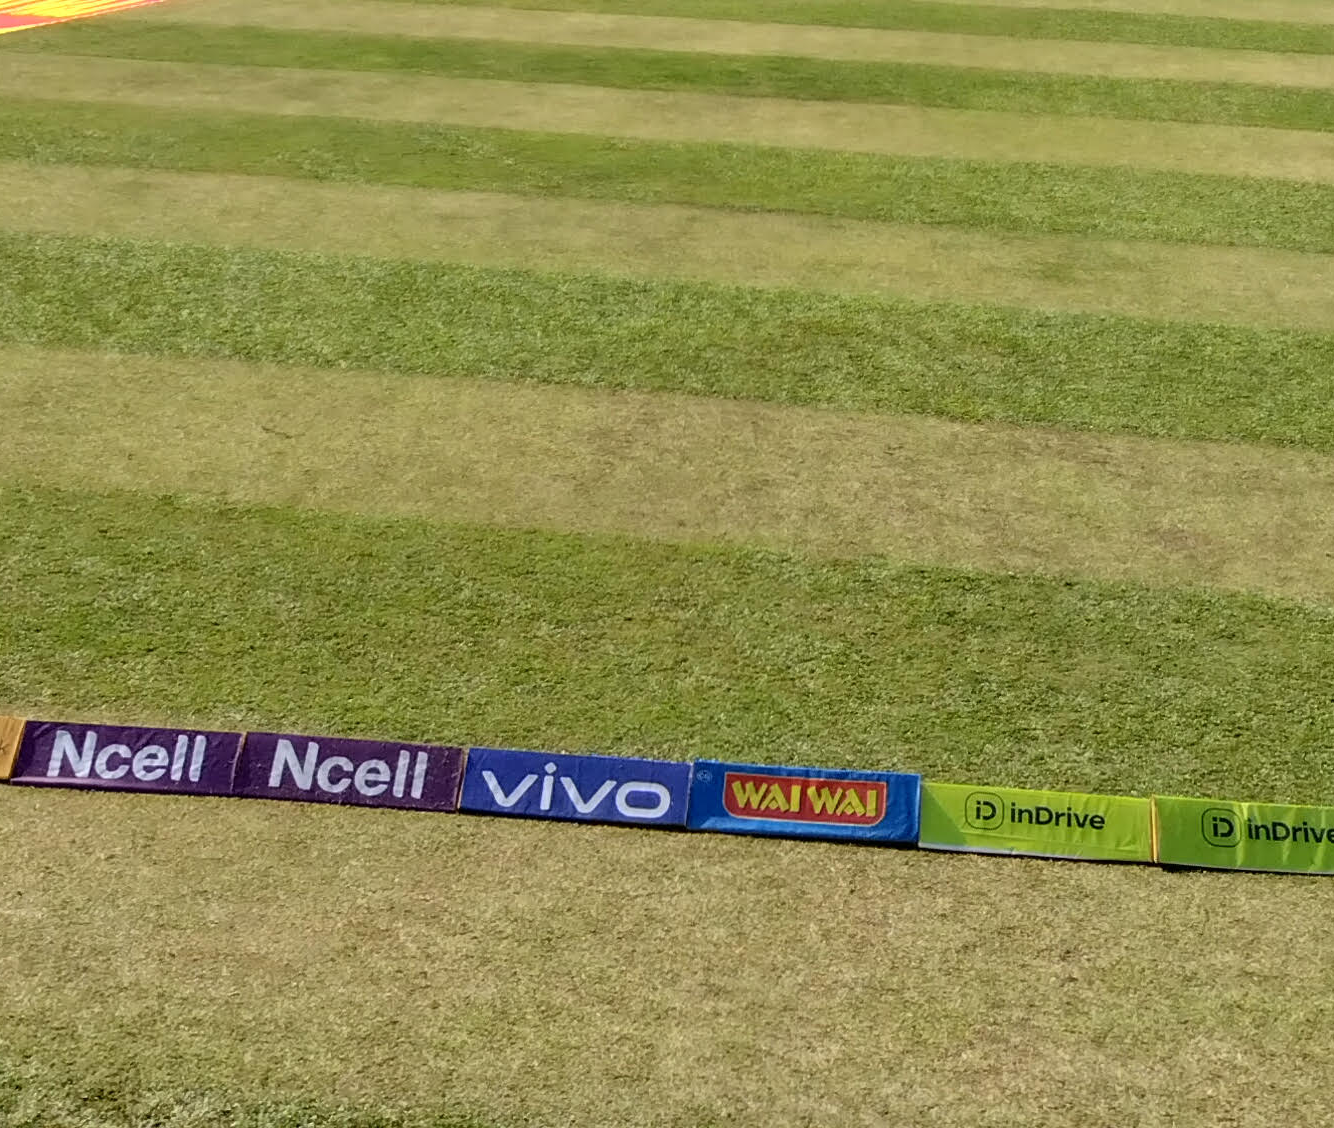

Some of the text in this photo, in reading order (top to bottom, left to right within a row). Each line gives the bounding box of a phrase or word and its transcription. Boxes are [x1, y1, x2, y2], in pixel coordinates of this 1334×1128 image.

[46, 729, 207, 783] Ncell
[267, 738, 429, 800] Ncell
[481, 762, 671, 818] vivo
[731, 779, 880, 818] WAI WAI
[1009, 801, 1106, 831] inDrive
